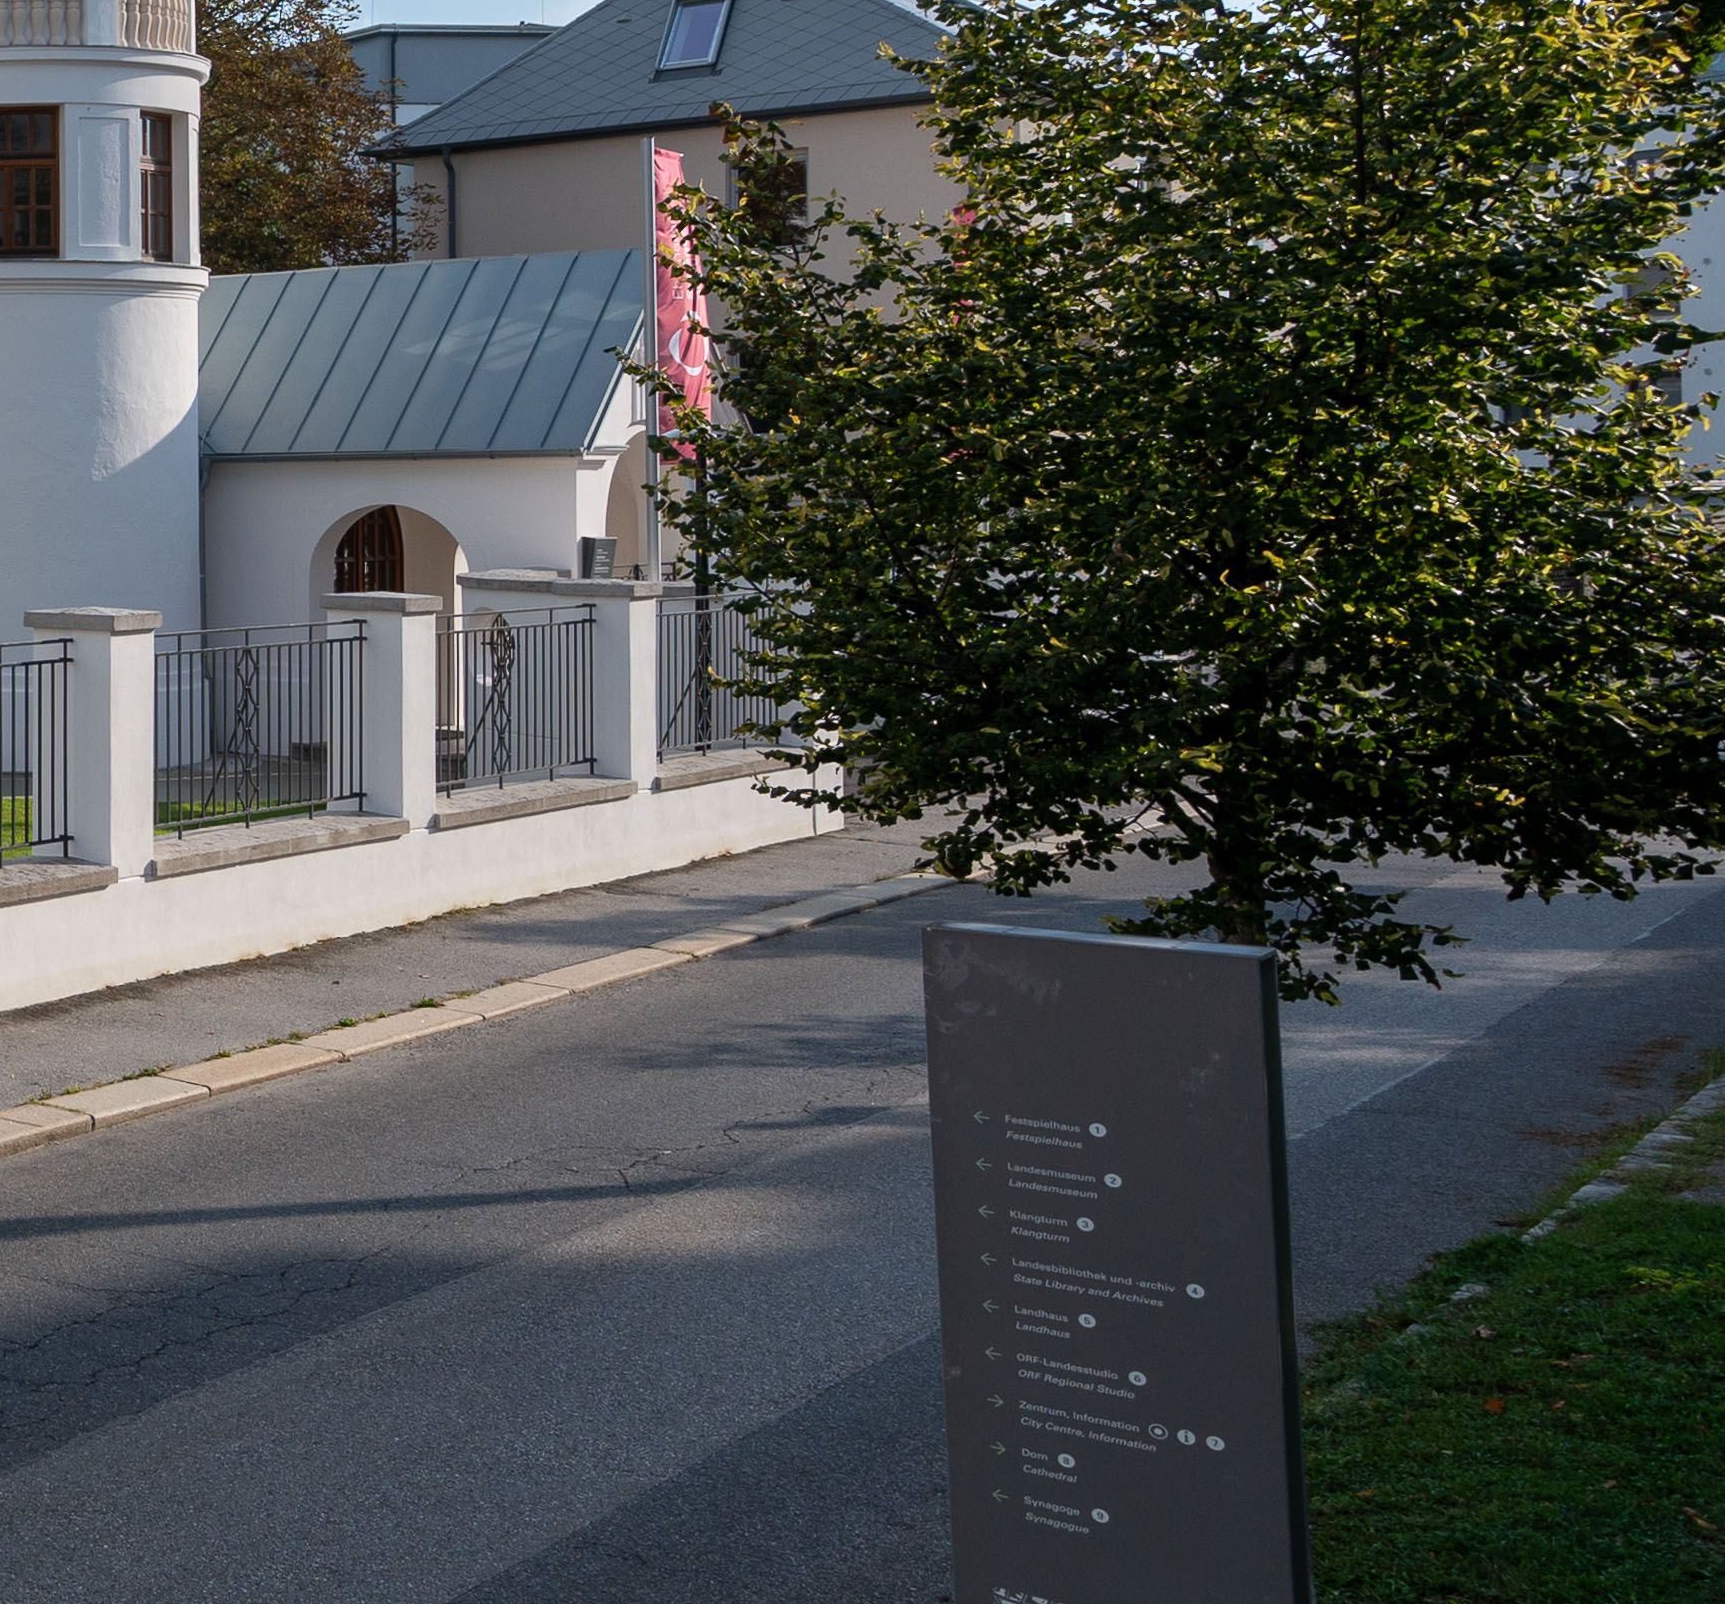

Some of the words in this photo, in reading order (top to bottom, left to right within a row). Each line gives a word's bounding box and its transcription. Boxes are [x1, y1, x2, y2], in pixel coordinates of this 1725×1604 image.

[1004, 1114, 1081, 1133] Festspielhaus
[1006, 1131, 1083, 1149] Festspielhaus
[1007, 1162, 1096, 1183] Landesmuseum
[1008, 1178, 1098, 1200] Landesmuseum
[1009, 1209, 1068, 1227] Klangturm
[1011, 1226, 1070, 1244] Klangturm
[1012, 1258, 1107, 1282] Landesbibliothek
[1110, 1275, 1132, 1287] und
[1135, 1278, 1175, 1294] -archiv
[1013, 1273, 1042, 1287] State
[1045, 1279, 1086, 1295] Library
[1087, 1286, 1110, 1298] and
[1112, 1291, 1165, 1308] Archives
[1014, 1304, 1069, 1323] Landhaus
[1016, 1321, 1070, 1340] Landhaus
[1016, 1352, 1119, 1381] ORF-Landesstudio
[1017, 1369, 1041, 1381] ORF
[1043, 1374, 1094, 1393] Regional
[1096, 1383, 1135, 1400] Studio
[1018, 1399, 1070, 1419] Zentrum,
[1072, 1411, 1140, 1433] Information
[1020, 1416, 1043, 1430] City
[1045, 1422, 1086, 1438] Centre,
[1088, 1430, 1157, 1452] Information
[1021, 1447, 1048, 1461] Dom
[1022, 1464, 1078, 1483] Cathedral
[1023, 1495, 1080, 1516] Synagoge
[1025, 1512, 1090, 1534] Synagogue
